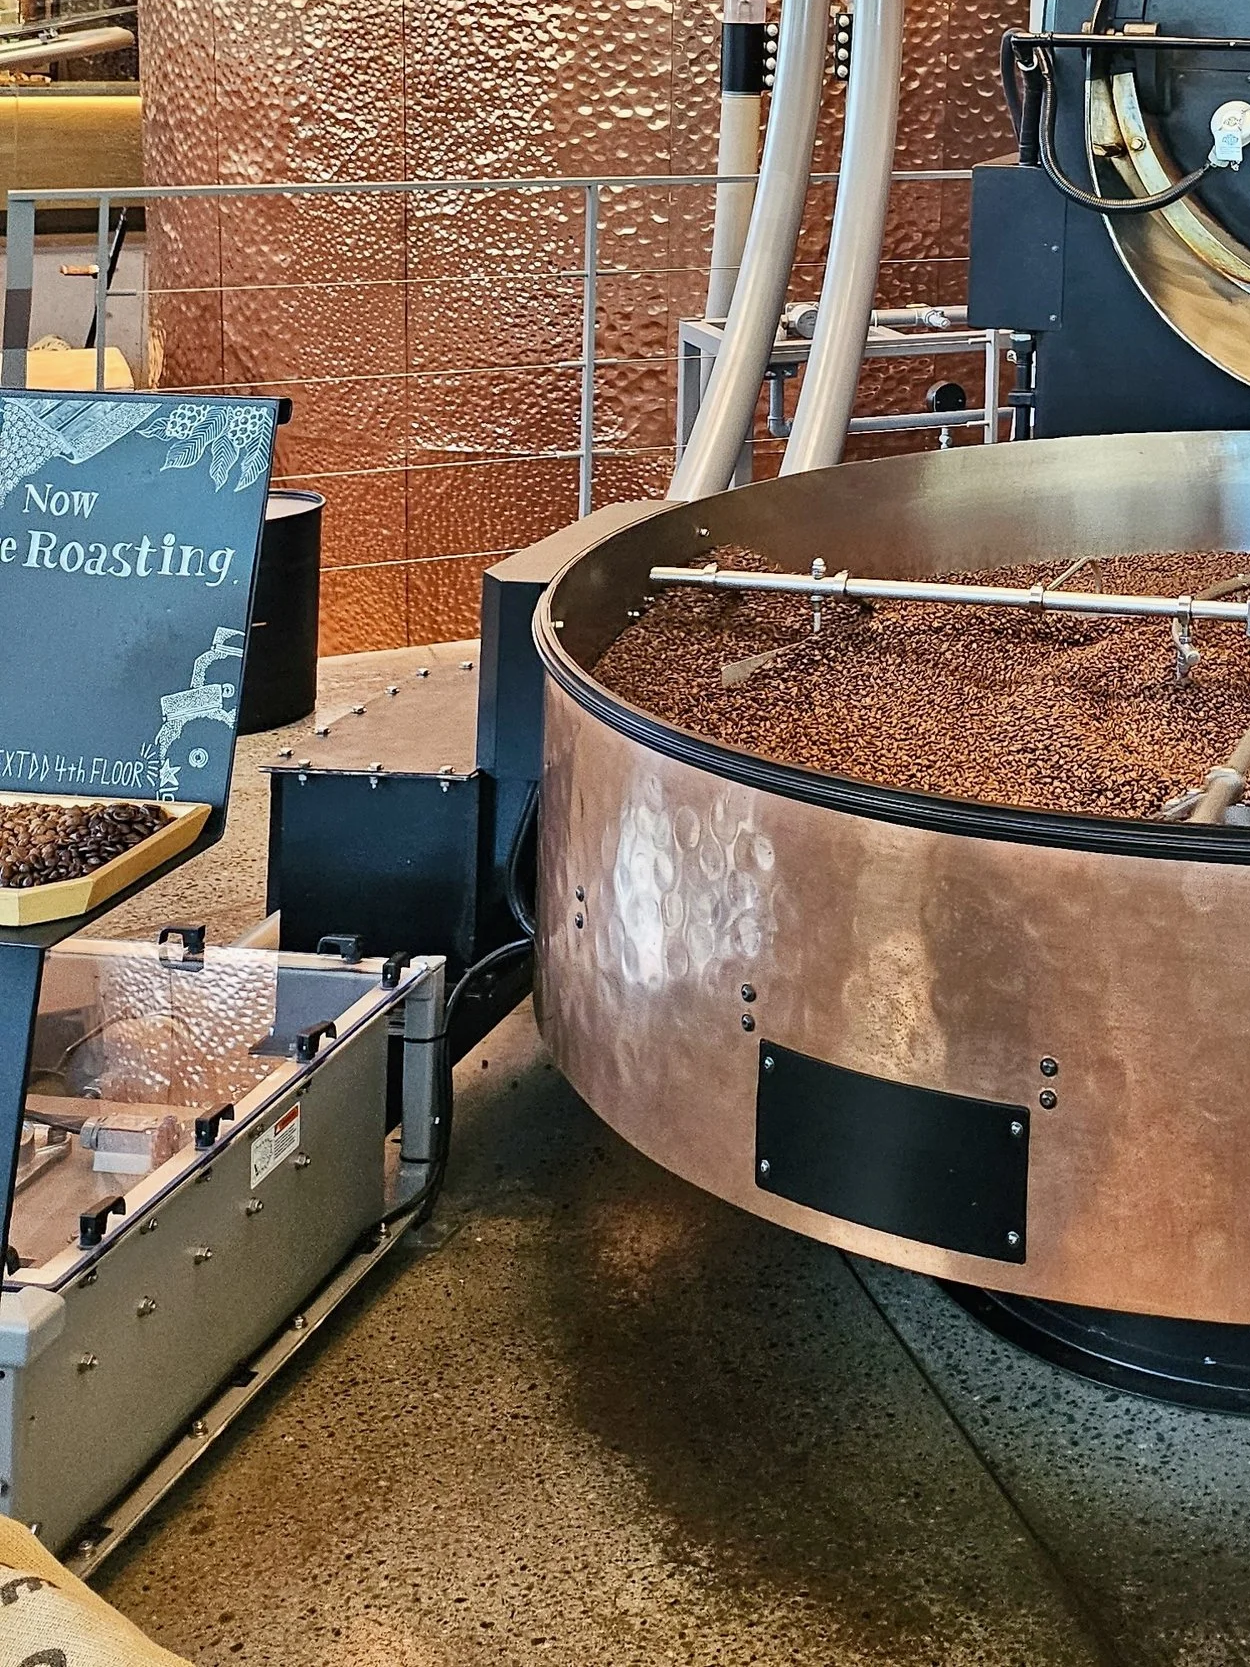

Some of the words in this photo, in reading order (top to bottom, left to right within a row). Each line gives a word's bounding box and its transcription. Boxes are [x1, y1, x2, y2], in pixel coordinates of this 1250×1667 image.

[22, 484, 100, 519] Now
[55, 754, 85, 783] 4th
[90, 758, 144, 788] FLOOR
